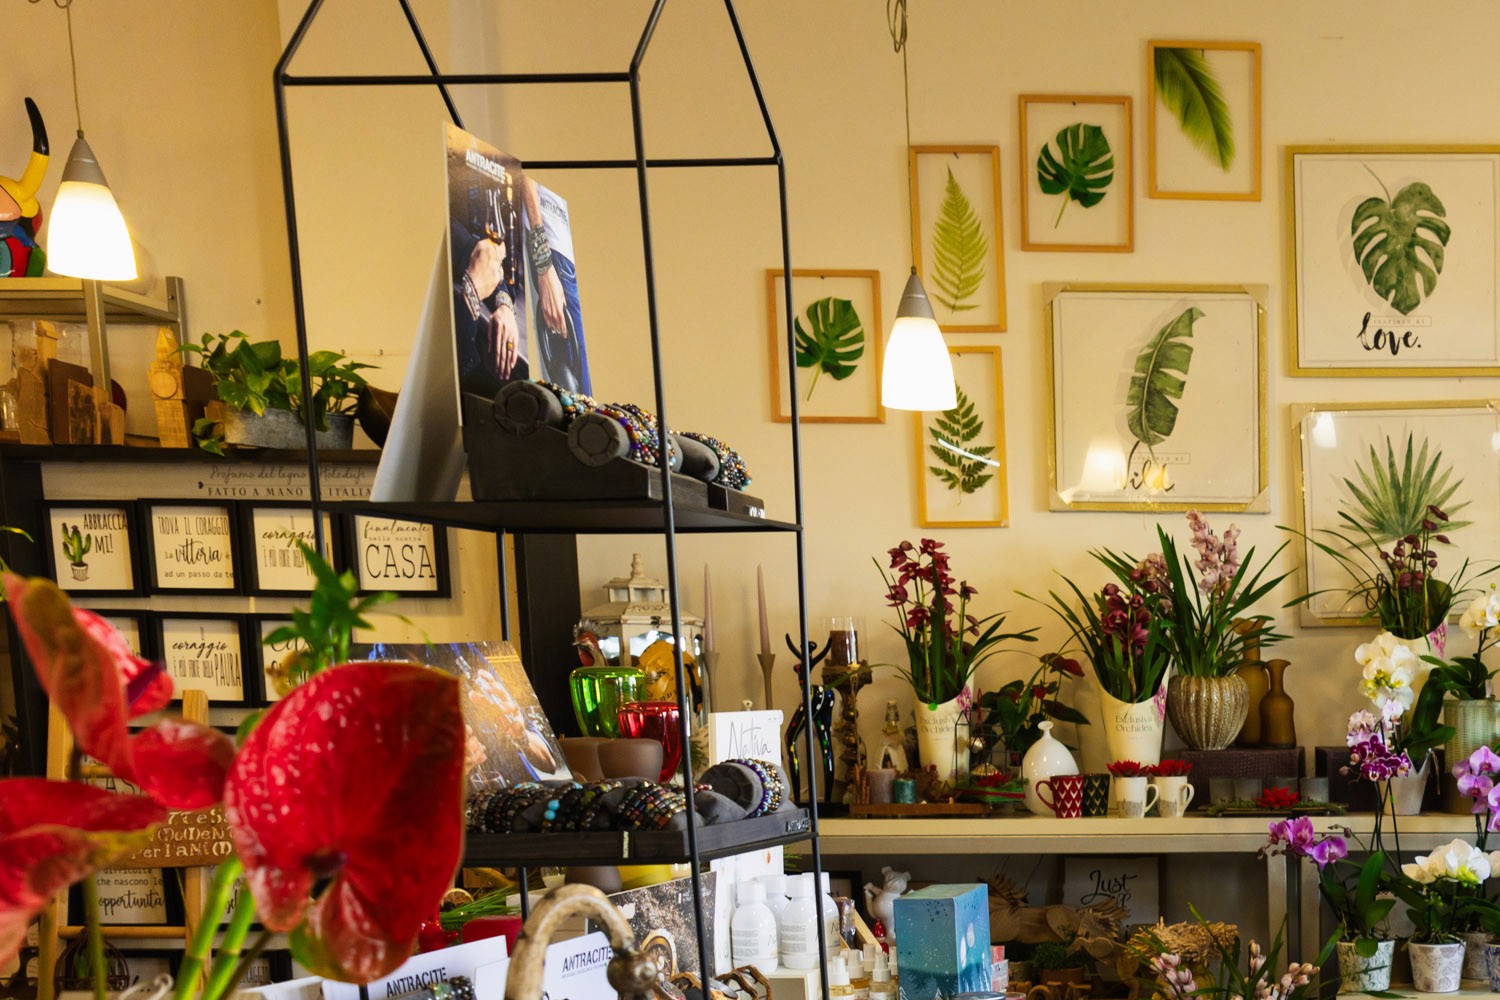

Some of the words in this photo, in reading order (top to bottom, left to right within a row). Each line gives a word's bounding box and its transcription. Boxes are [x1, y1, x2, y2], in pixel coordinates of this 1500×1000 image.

[465, 149, 506, 180] ANTRACITE
[257, 464, 275, 479] del
[208, 487, 247, 497] FATTO
[252, 487, 259, 497] A
[266, 487, 304, 497] MANO
[83, 513, 127, 531] ABBRACCIA
[158, 515, 179, 535] TROVA
[185, 516, 192, 535] IL
[195, 516, 231, 536] CORAGGIO
[363, 519, 430, 540] finalmente
[95, 533, 114, 554] MI!
[164, 551, 173, 560] la
[174, 538, 222, 566] vittoria
[366, 543, 436, 579] CASA
[188, 571, 210, 580] passo
[213, 571, 223, 579] da
[172, 640, 229, 659] coraggio
[214, 652, 242, 687] PAURA
[97, 878, 111, 886] che
[1080, 869, 1138, 905] Just
[99, 889, 164, 916] opportunità
[562, 945, 613, 973] ANTRACITE
[386, 966, 448, 998] ANTRACITE
